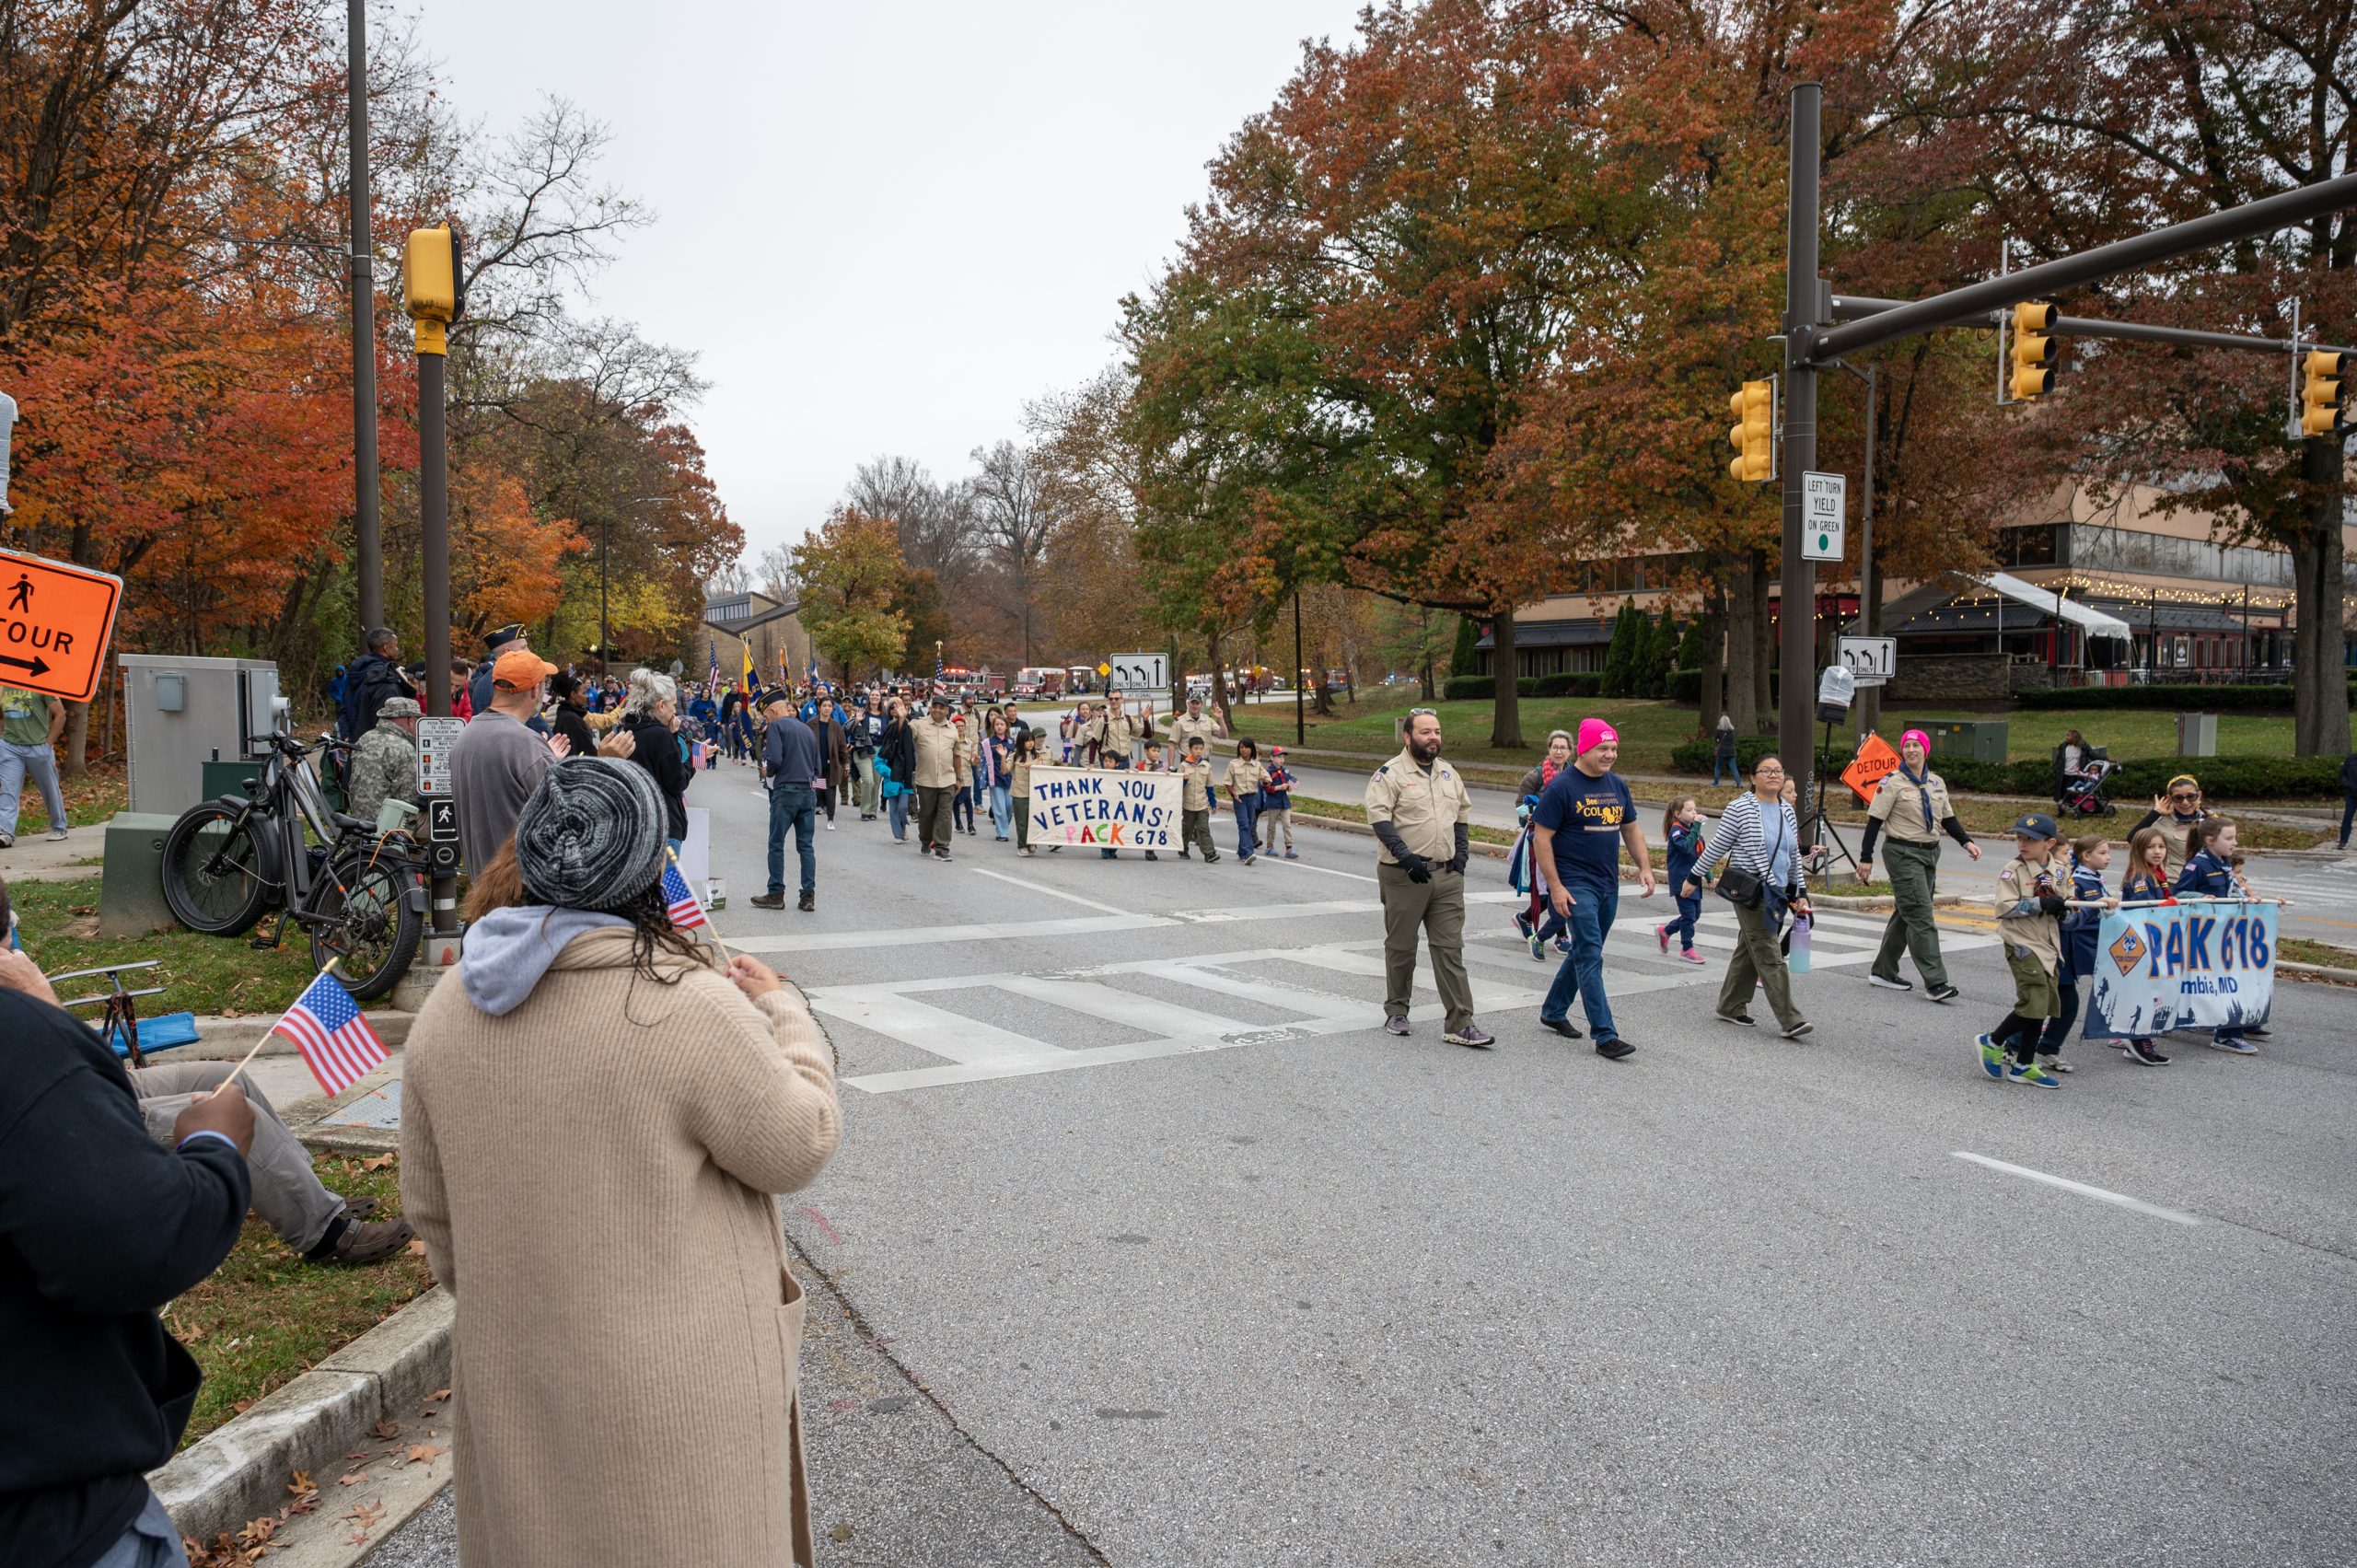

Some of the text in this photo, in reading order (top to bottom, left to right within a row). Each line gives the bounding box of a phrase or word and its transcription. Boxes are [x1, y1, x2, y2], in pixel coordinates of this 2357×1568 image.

[1808, 480, 1841, 494] LEFT TURN
[1814, 497, 1836, 512] YIELD
[1808, 519, 1840, 532] ON GREEN
[1857, 757, 1897, 774] DETOUR
[1034, 778, 1155, 801] THANK YOU
[1033, 799, 1173, 830] VETERANS!
[1065, 822, 1167, 845] PACK 678
[2221, 914, 2270, 971] 618
[2219, 976, 2238, 994] MD
